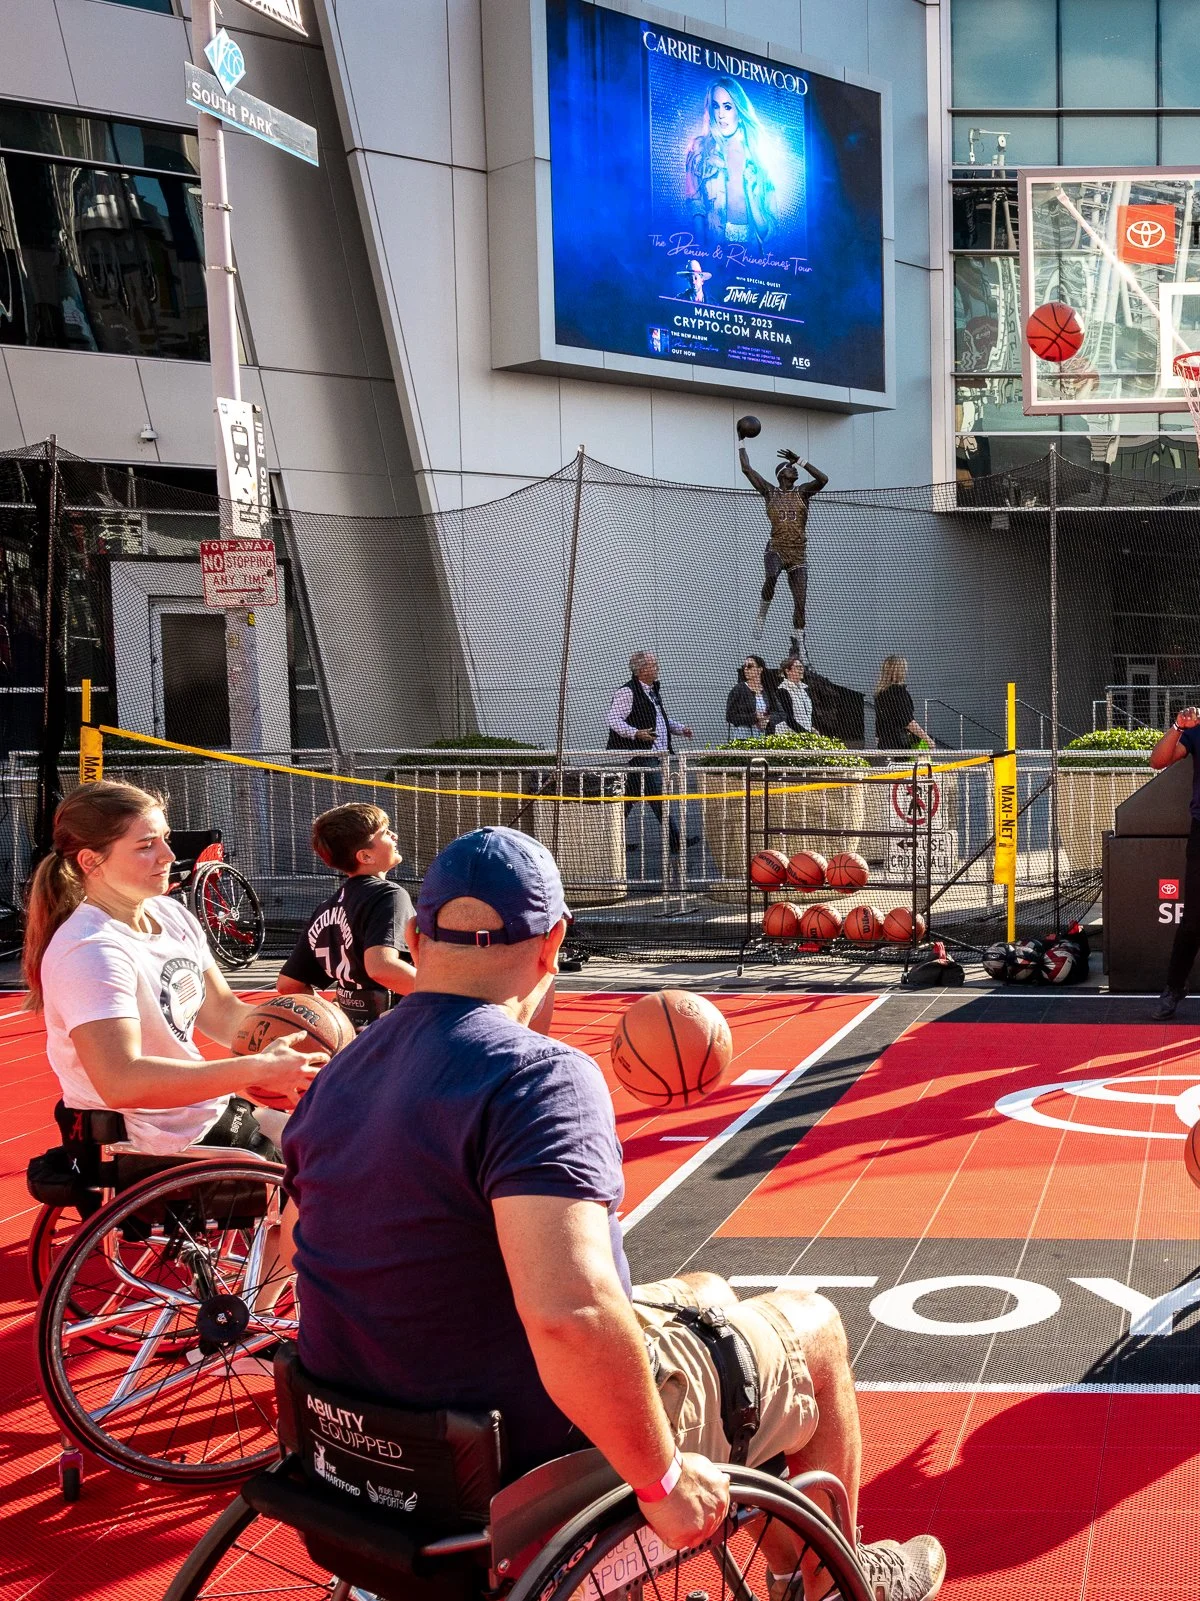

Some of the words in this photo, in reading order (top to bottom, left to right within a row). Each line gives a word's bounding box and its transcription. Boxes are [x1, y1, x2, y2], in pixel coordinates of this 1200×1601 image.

[642, 30, 702, 65] CARRIE
[705, 49, 809, 96] UNDERWOOD
[191, 82, 236, 118] SOUTH
[240, 105, 273, 136] PARK
[648, 234, 667, 248] The
[667, 231, 710, 256] Denim
[712, 245, 723, 260] &
[726, 243, 791, 270] Rhinestones
[789, 257, 813, 276] Tour
[747, 277, 765, 286] SPECIAL
[724, 286, 759, 304] JIMMIE
[759, 291, 791, 311] ALLEN
[673, 315, 750, 338] CRYPTO.COM
[755, 328, 792, 345] ARENA
[694, 307, 730, 322] MARCH
[734, 315, 747, 326] 13,
[751, 317, 773, 329] 2023
[791, 356, 811, 367] AEG
[255, 421, 265, 459] Rail
[202, 541, 271, 551] TOW-AWAY
[203, 554, 223, 572] NO
[226, 556, 273, 569] STOPPING
[213, 575, 235, 586] ANY
[243, 574, 269, 586] TIME
[1001, 785, 1016, 840] MAXI-NET
[306, 1393, 364, 1433] ABILITY
[318, 1416, 403, 1459] EQUIPPED
[325, 1461, 337, 1475] THE
[325, 1472, 361, 1497] HARTFORD
[393, 1489, 404, 1499] CITY
[378, 1494, 406, 1510] SPORTS
